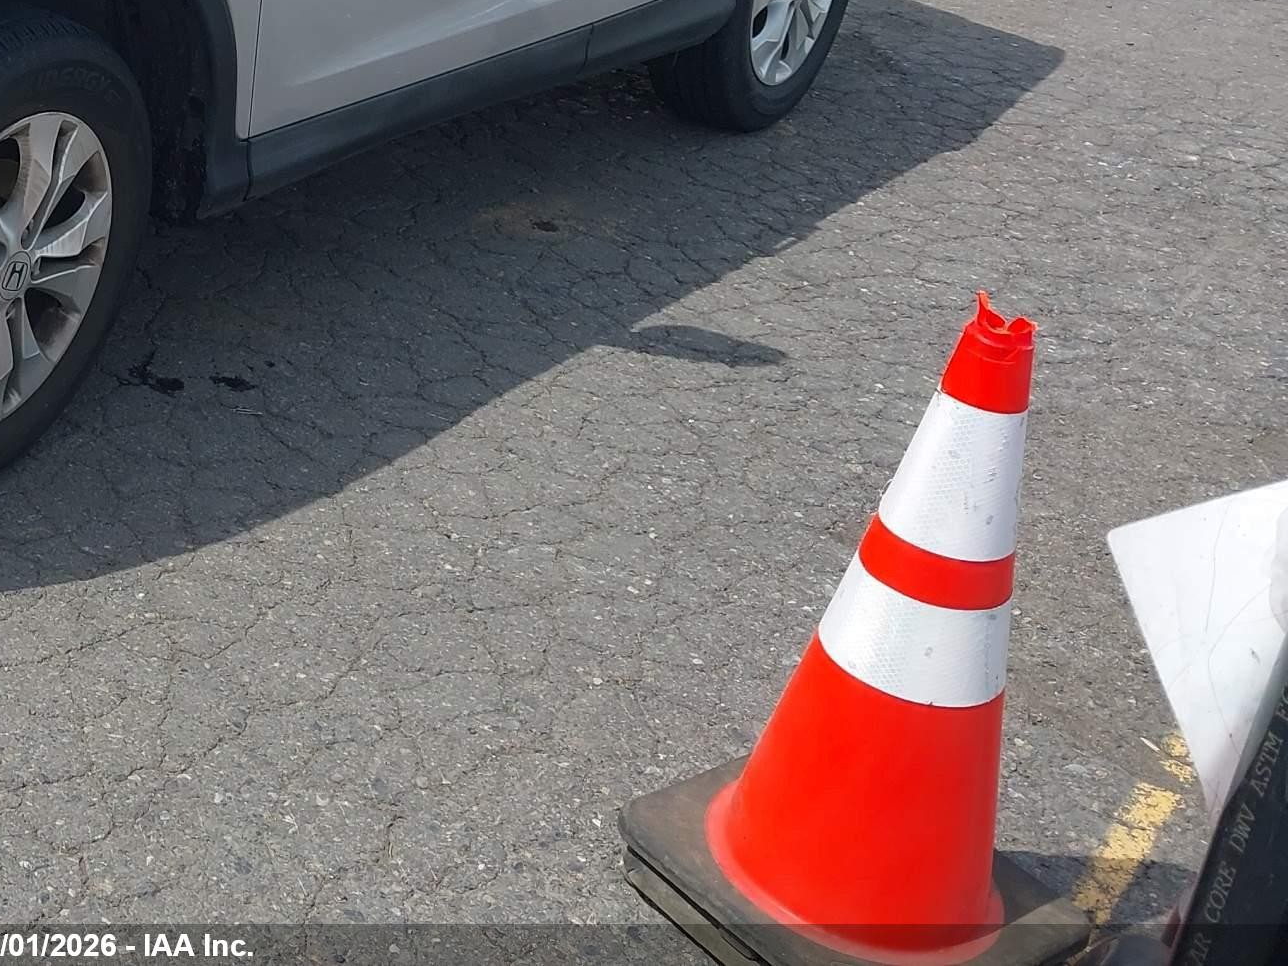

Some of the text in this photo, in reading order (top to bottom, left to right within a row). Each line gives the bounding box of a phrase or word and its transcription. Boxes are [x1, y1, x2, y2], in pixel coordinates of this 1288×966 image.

[1204, 860, 1238, 924] CORE
[1228, 804, 1257, 854] DWV
[1248, 730, 1286, 798] ASTM
